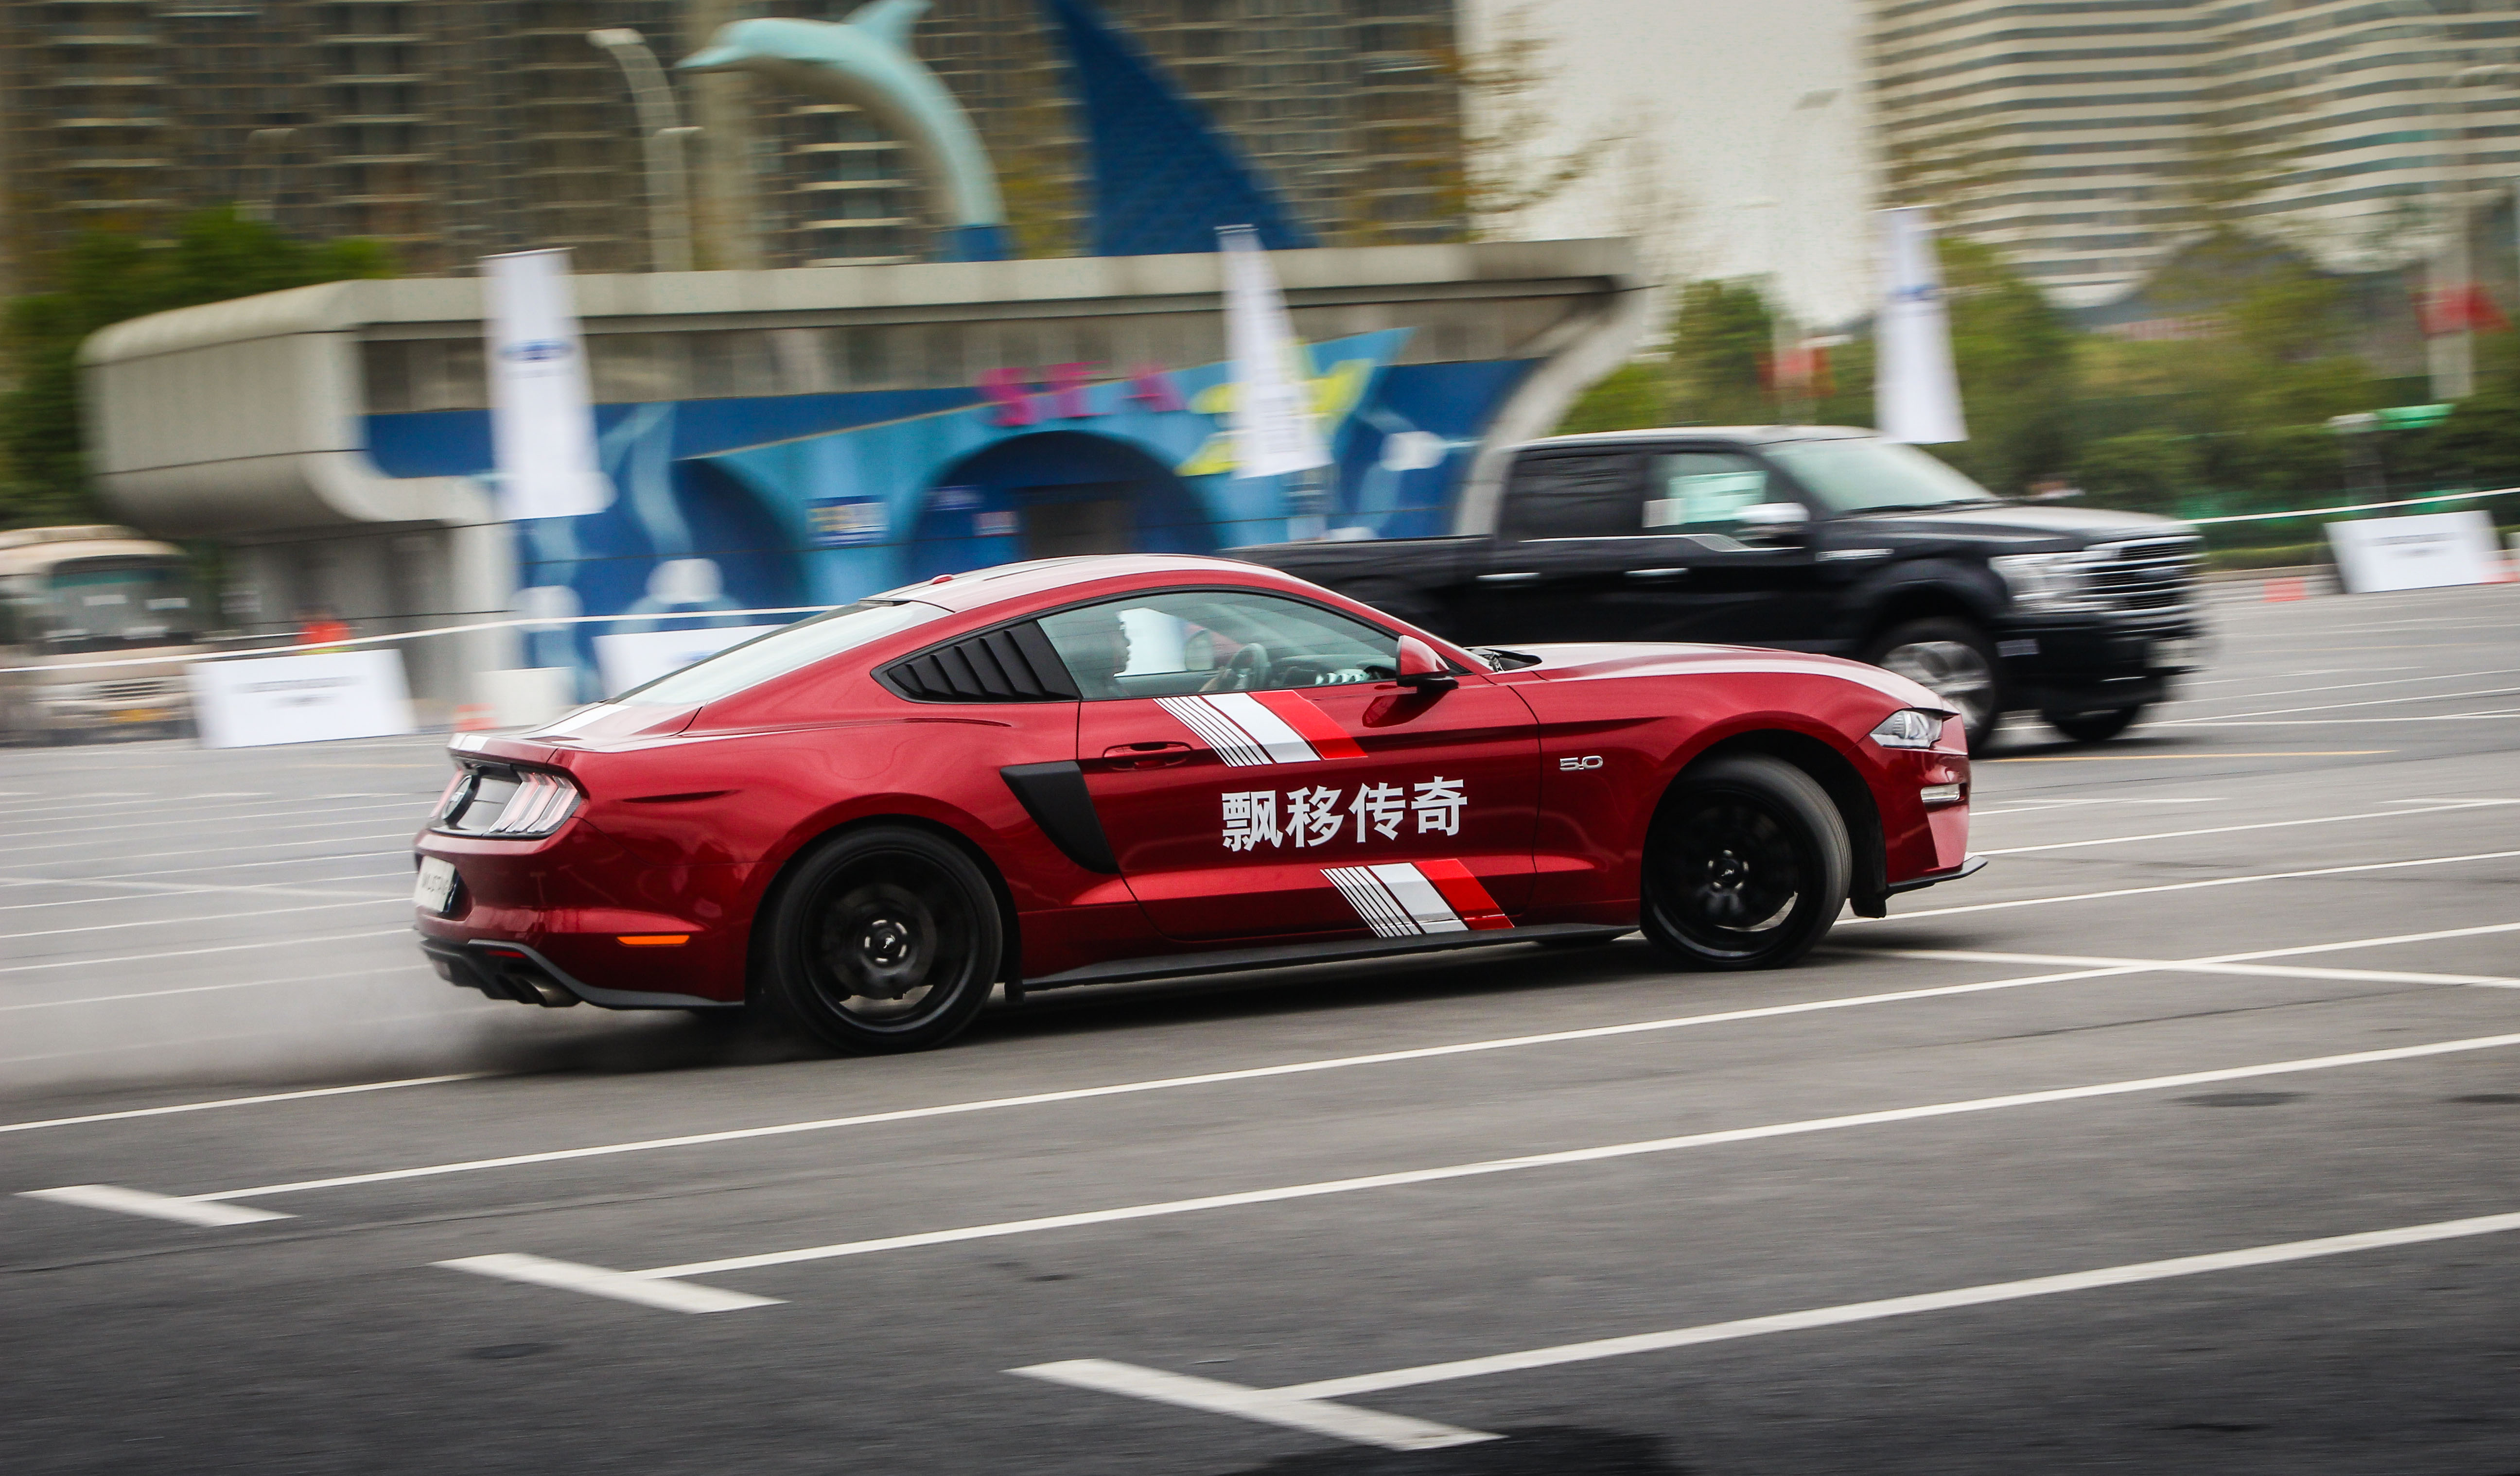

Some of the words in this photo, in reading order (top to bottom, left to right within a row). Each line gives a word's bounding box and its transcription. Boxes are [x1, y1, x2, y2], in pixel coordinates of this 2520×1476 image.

[1559, 755, 1603, 771] 5.0
[1222, 776, 1467, 852] 飘移传奇
